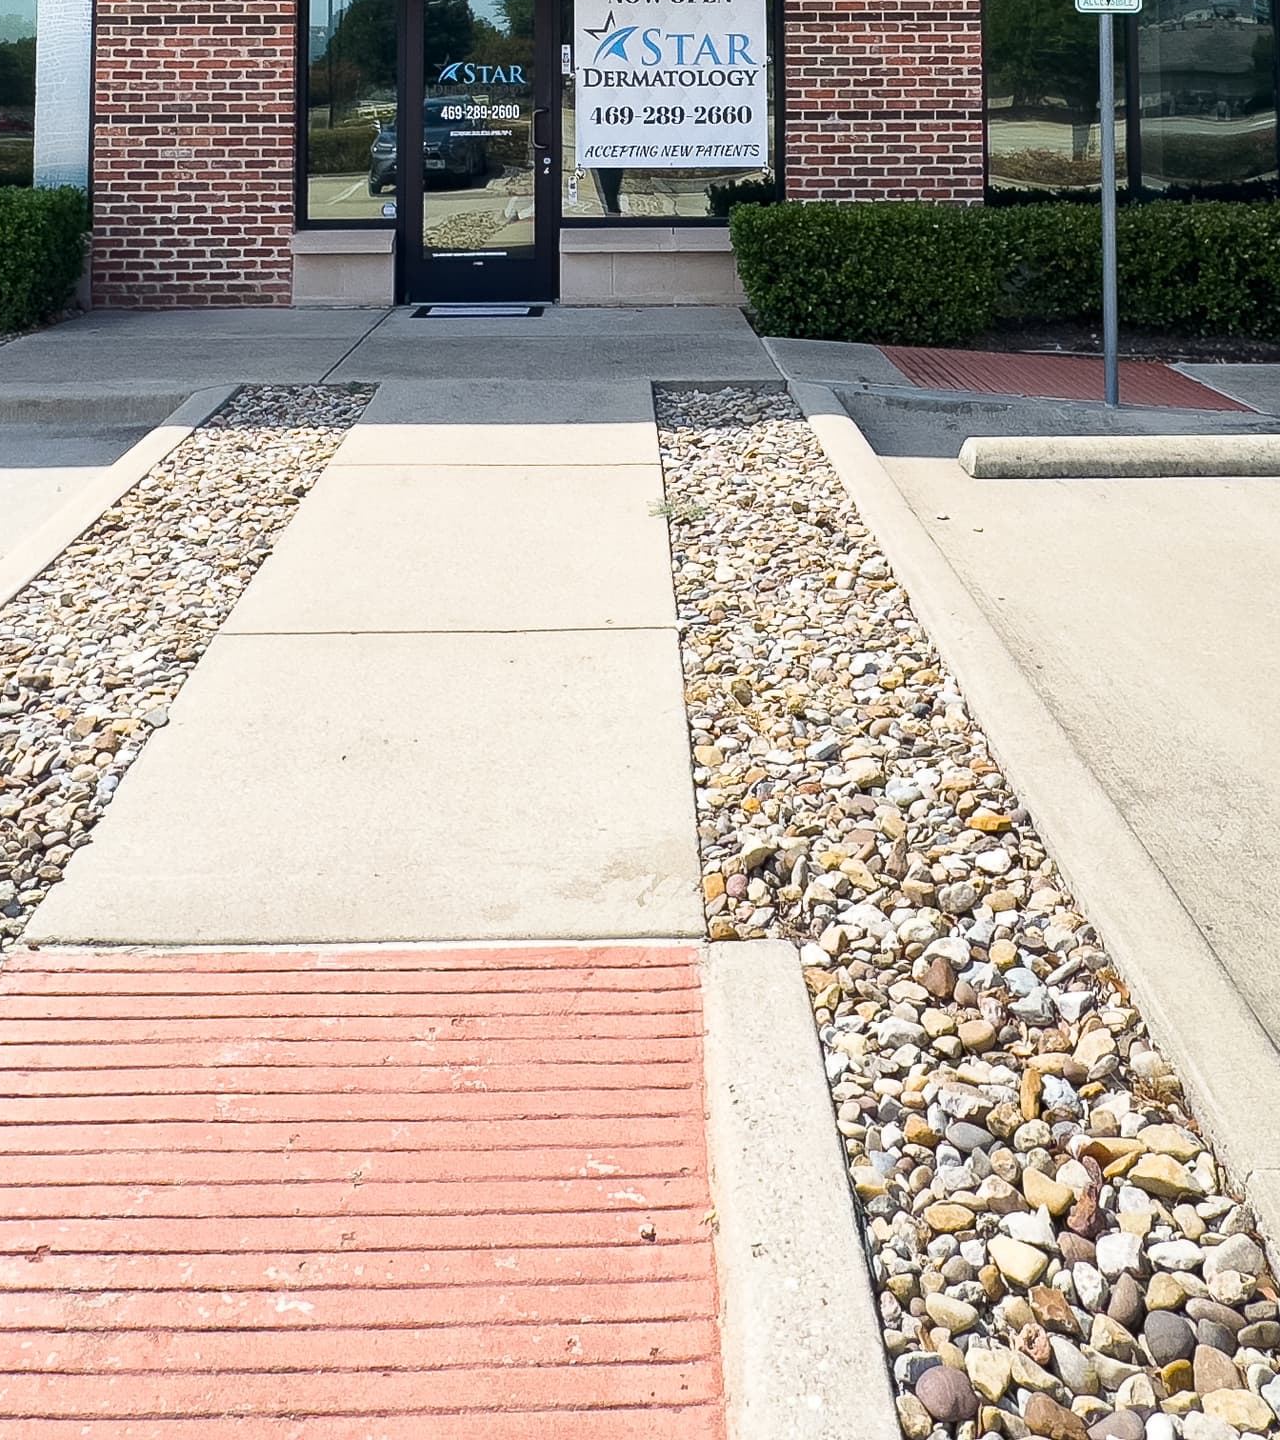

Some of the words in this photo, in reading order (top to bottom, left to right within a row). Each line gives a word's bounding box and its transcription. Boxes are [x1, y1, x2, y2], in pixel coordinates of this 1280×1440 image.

[641, 28, 757, 66] STAR
[463, 62, 527, 84] STAR
[583, 68, 759, 87] DERMATOLOGY
[440, 104, 520, 120] 469-289-2600
[590, 105, 752, 125] 469-289-2660
[584, 145, 658, 158] ACCEPTING
[661, 145, 693, 157] NEW
[695, 144, 760, 157] PATIENTS
